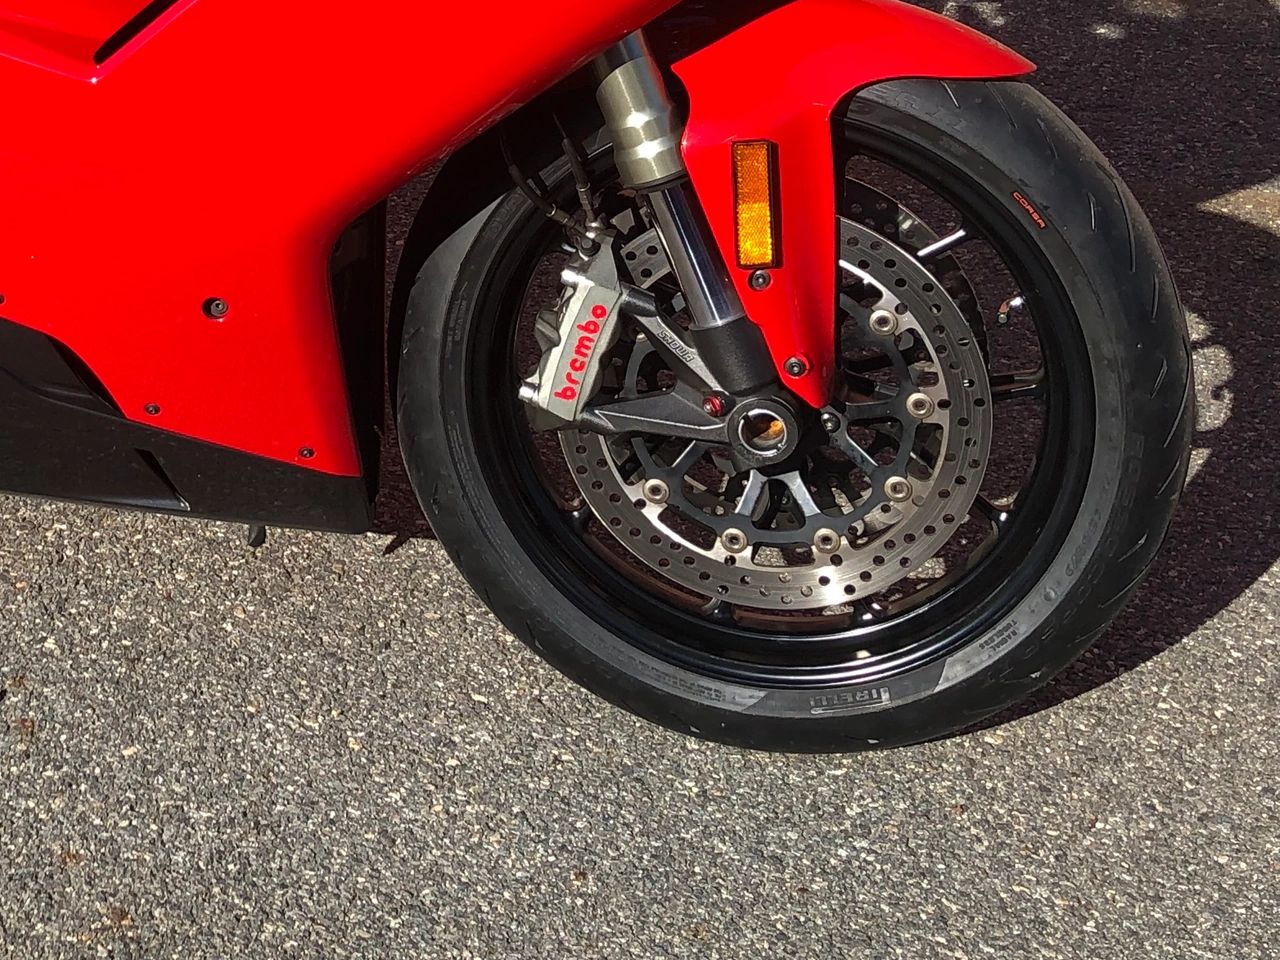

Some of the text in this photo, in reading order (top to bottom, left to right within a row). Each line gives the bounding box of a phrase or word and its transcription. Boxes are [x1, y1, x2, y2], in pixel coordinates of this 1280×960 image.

[1012, 191, 1046, 228] CORSA
[554, 304, 608, 401] brembo
[656, 329, 695, 363] SHOWA
[809, 686, 892, 715] PIRELLI
